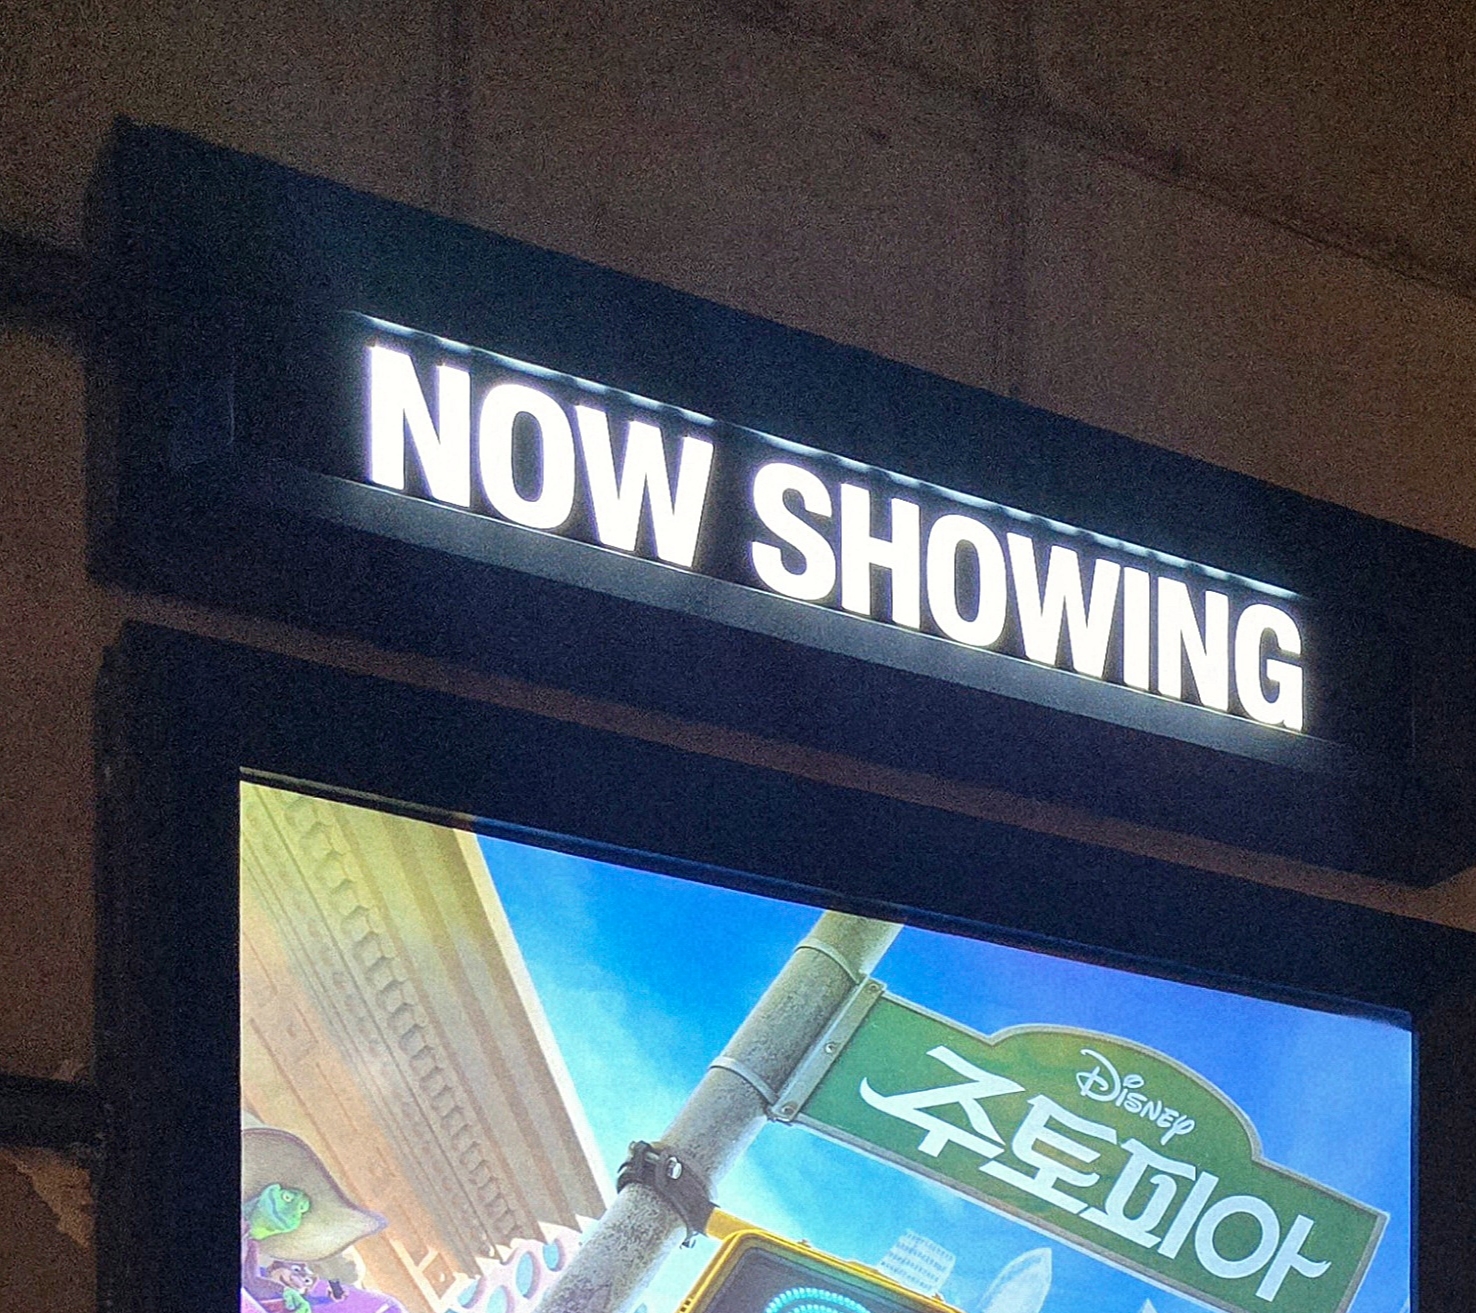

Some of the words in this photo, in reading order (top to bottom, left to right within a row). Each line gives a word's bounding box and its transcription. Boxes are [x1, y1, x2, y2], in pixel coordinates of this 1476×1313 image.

[364, 343, 713, 571] NOW
[750, 460, 1305, 733] SHOWING
[859, 1045, 1332, 1301] 주토피아
[1076, 1048, 1195, 1145] Disney
